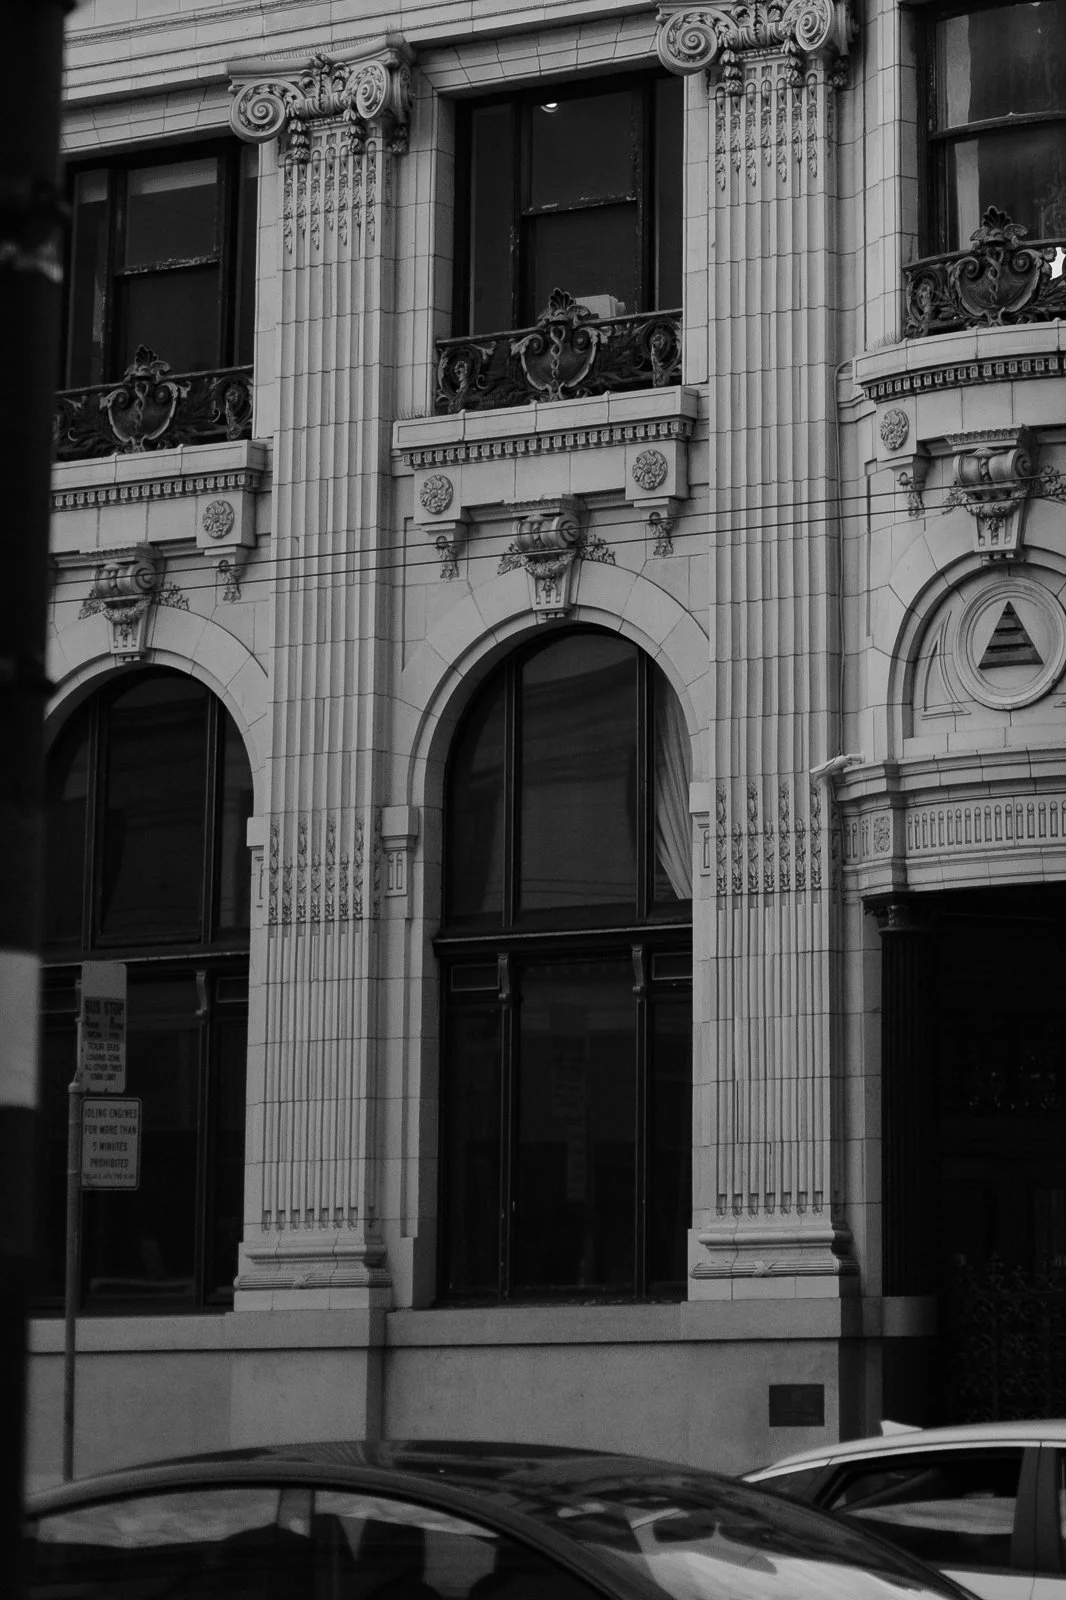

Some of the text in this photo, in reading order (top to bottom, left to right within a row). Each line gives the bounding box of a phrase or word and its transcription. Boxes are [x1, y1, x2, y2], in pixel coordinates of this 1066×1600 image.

[85, 1000, 124, 1015] BUS STOP
[107, 1043, 120, 1052] BUS
[85, 1108, 137, 1118] IDLING ENGINES
[85, 1124, 136, 1135] FOR MORE THAN
[99, 1141, 128, 1152] MINUTES
[90, 1158, 129, 1168] PROHIBITED
